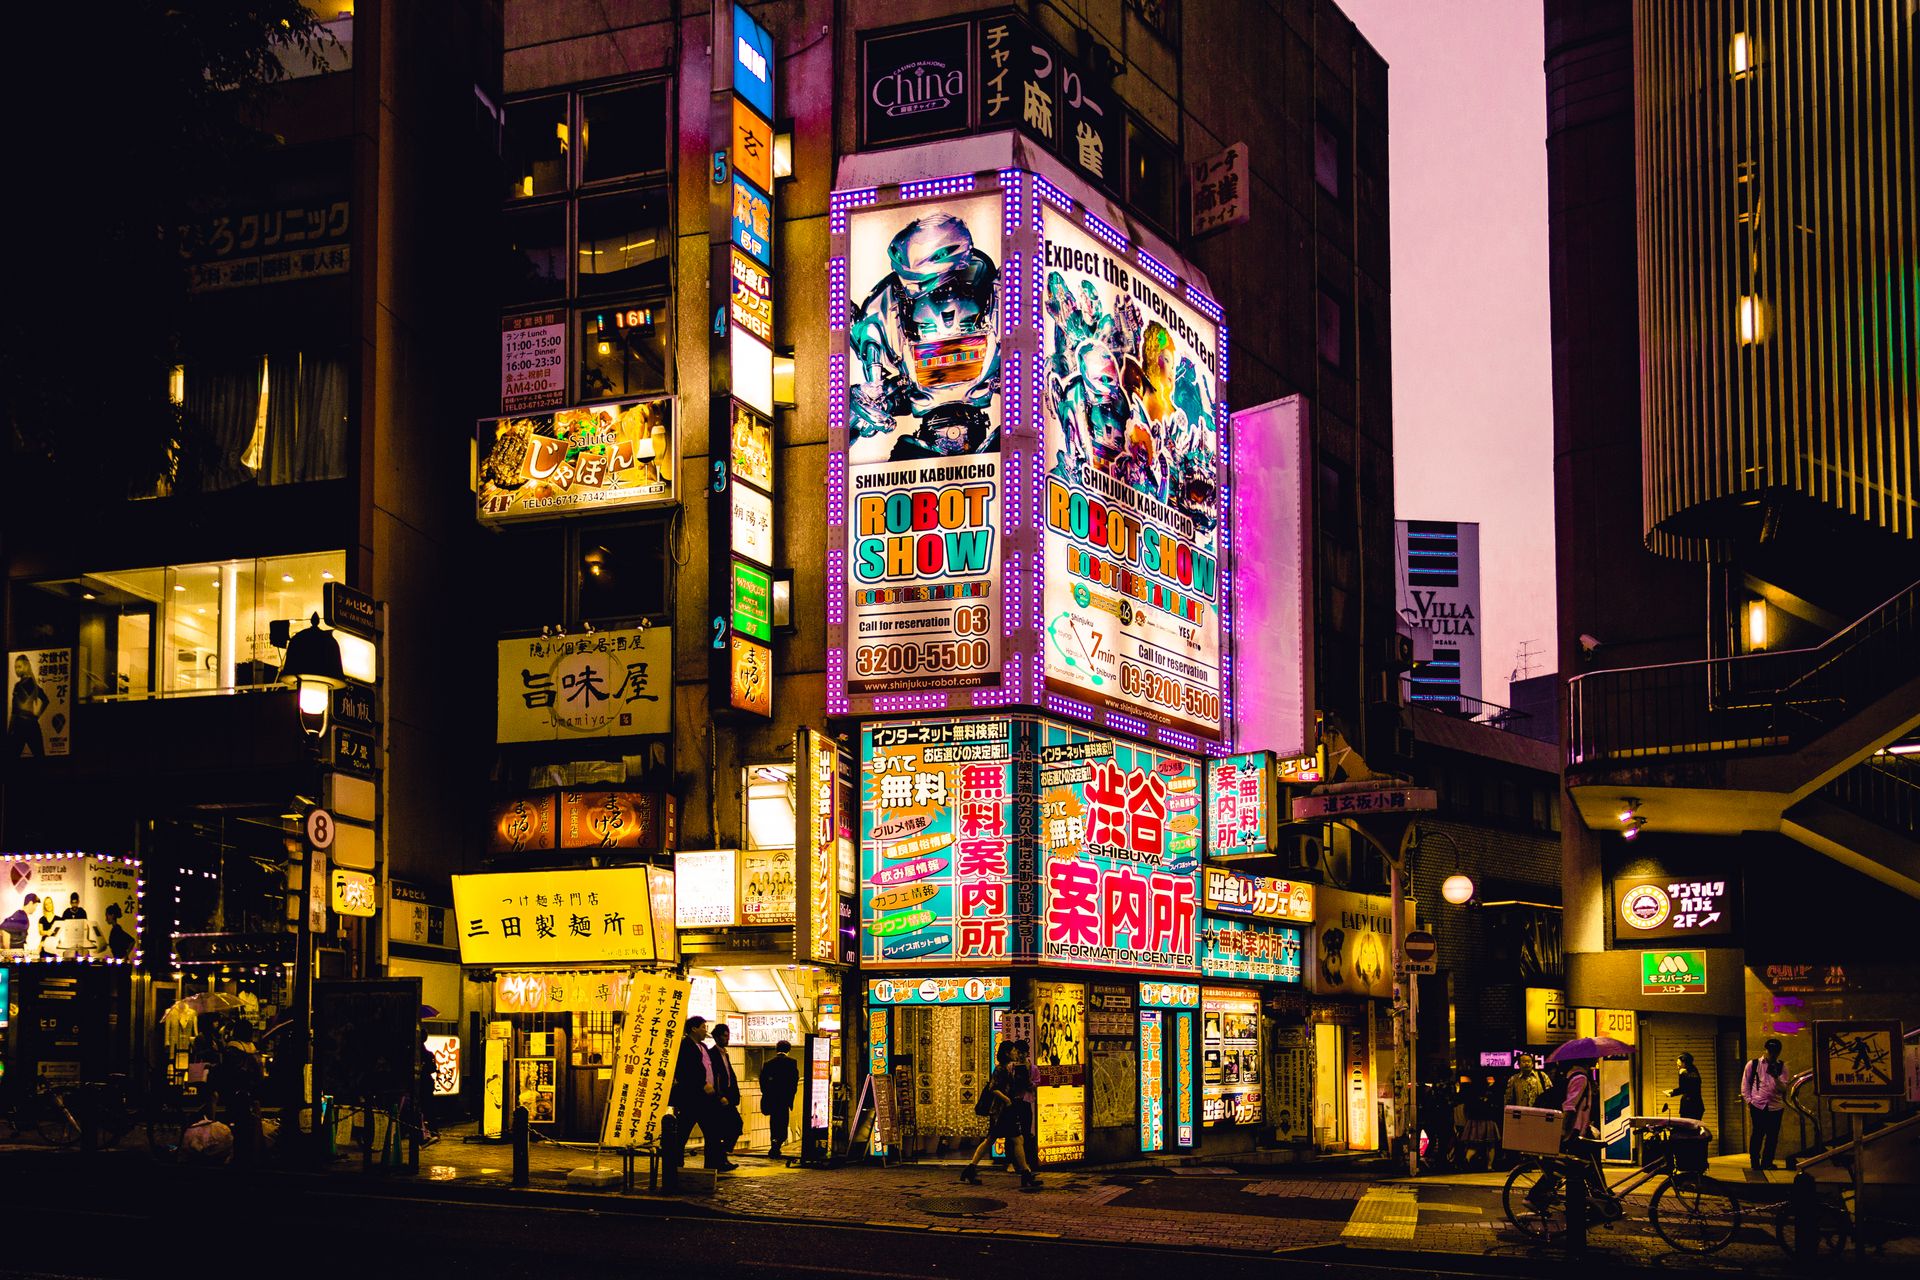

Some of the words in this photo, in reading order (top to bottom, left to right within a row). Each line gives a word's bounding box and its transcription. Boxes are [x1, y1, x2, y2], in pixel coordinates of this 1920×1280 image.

[986, 24, 1010, 117] チャイナ
[872, 66, 963, 108] China
[713, 150, 727, 184] 5
[733, 257, 770, 297] 出会い
[737, 282, 769, 319] カフェ
[1044, 239, 1101, 276] Expect
[1102, 257, 1129, 292] the
[1132, 276, 1216, 377] unexpected
[527, 328, 547, 338] Lunch
[713, 304, 726, 338] 4
[732, 303, 770, 339] 受付6F
[506, 335, 562, 352] 11:00-15:00
[534, 347, 556, 356] Dinner
[506, 355, 561, 372] 16:00-23:30
[505, 379, 548, 395] AM4:00
[531, 438, 633, 489] じゃぽん
[713, 459, 727, 493] 3
[856, 470, 917, 489] SHINJUKU
[919, 463, 996, 482] KABUKICHO
[483, 493, 516, 516] 4F
[522, 490, 605, 510] TEL03-6712-7342
[859, 486, 990, 537] ROBOT
[1083, 467, 1136, 508] SHINJUKU
[1136, 489, 1193, 534] KABUKICHO
[1049, 481, 1141, 562] ROBOT
[1142, 526, 1216, 598] SHOW
[858, 529, 989, 579] SHOW
[857, 587, 902, 605] ROBOT
[903, 582, 990, 602] RESTAURANT
[1068, 545, 1120, 590] ROBOT
[1120, 568, 1204, 627] RESTAURANT
[1410, 590, 1475, 619] VILLA
[713, 615, 726, 649] 2
[858, 620, 878, 632] Call
[879, 619, 894, 632] for
[894, 616, 951, 630] reservation
[956, 607, 988, 636] 03
[1070, 612, 1095, 628] Shinjuku
[858, 640, 988, 674] 3200-5500
[1090, 630, 1103, 658] 7
[1097, 649, 1116, 665] min
[740, 647, 759, 703] まるげん
[1095, 666, 1117, 682] Shibuya
[1138, 644, 1154, 658] Call
[1154, 650, 1166, 662] for
[1166, 653, 1209, 682] reservation
[520, 662, 659, 710] 旨味屋
[864, 675, 981, 692] www.shinjuku-robot.com
[1120, 663, 1219, 720] 03-3200-5500
[1104, 698, 1172, 726] www.shinjuku-robot.com
[872, 754, 917, 774] すべて
[567, 793, 583, 804] 2F
[880, 771, 949, 808] 無料
[1323, 792, 1405, 813] 道玄坂小路
[1042, 801, 1067, 818] すべて
[1084, 759, 1167, 854] 渋谷
[1216, 765, 1238, 849] 案内所
[1239, 779, 1258, 831] 無料
[313, 814, 328, 844] 8
[594, 792, 625, 849] まるげん
[873, 816, 926, 839] グルメ情報
[1049, 815, 1085, 849] 無料
[959, 763, 1008, 957] 無料案内所
[1089, 843, 1161, 866] SHIBUYA
[880, 860, 940, 883] 飲み屋情報
[501, 891, 600, 908] つけ麺専門店
[874, 884, 934, 908] カフェ情報
[1208, 873, 1253, 904] 出会い
[1275, 881, 1288, 892] 6F
[1667, 882, 1725, 898] サンマルク
[124, 901, 136, 915] 2F
[744, 904, 760, 912] 6F
[1048, 858, 1195, 955] 案内所
[1253, 888, 1289, 917] カフェ
[467, 912, 626, 940] 三田製麺所
[1672, 914, 1699, 928] 2F
[818, 940, 832, 958] 6F
[1045, 941, 1144, 962] INFORMATION
[1142, 951, 1194, 966] CENTER
[1219, 929, 1283, 960] 無料案内所
[1648, 974, 1700, 983] モスバーガー
[1547, 1008, 1577, 1030] 209
[1608, 1013, 1633, 1032] 209
[1203, 1099, 1236, 1121] 出会い
[1235, 1104, 1261, 1123] カフェ
